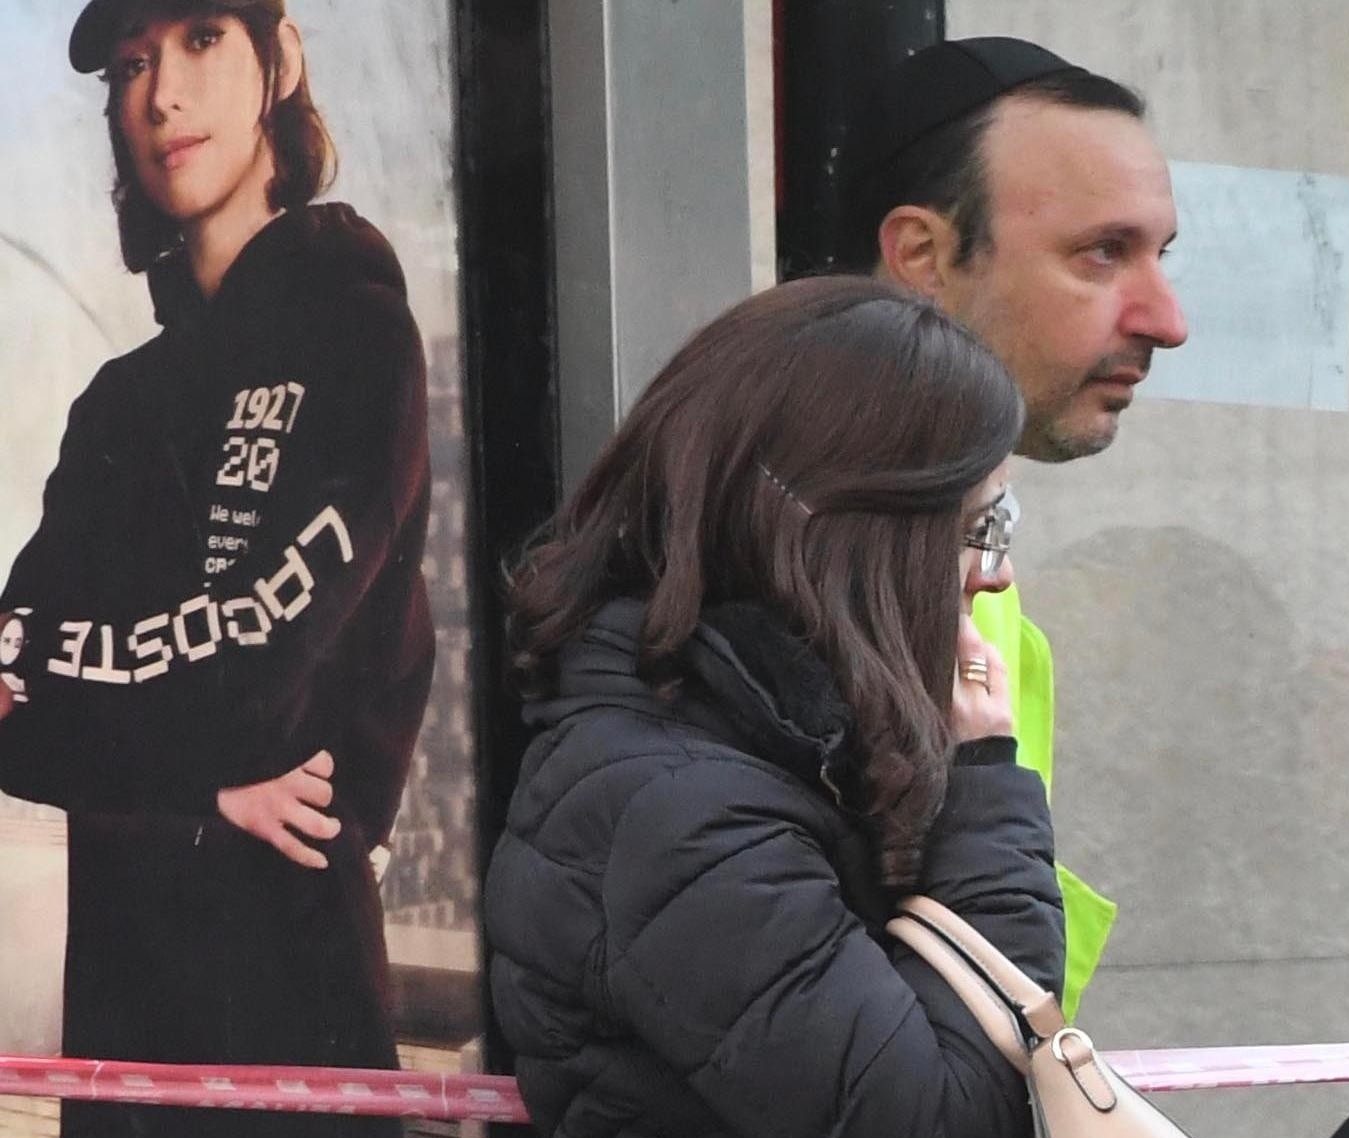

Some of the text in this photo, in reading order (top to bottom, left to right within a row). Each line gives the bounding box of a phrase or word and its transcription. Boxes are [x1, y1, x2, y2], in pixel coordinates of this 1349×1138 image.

[226, 381, 305, 434] 1927
[216, 436, 280, 492] 20
[209, 504, 261, 527] We wel
[47, 505, 354, 684] LACOSTE
